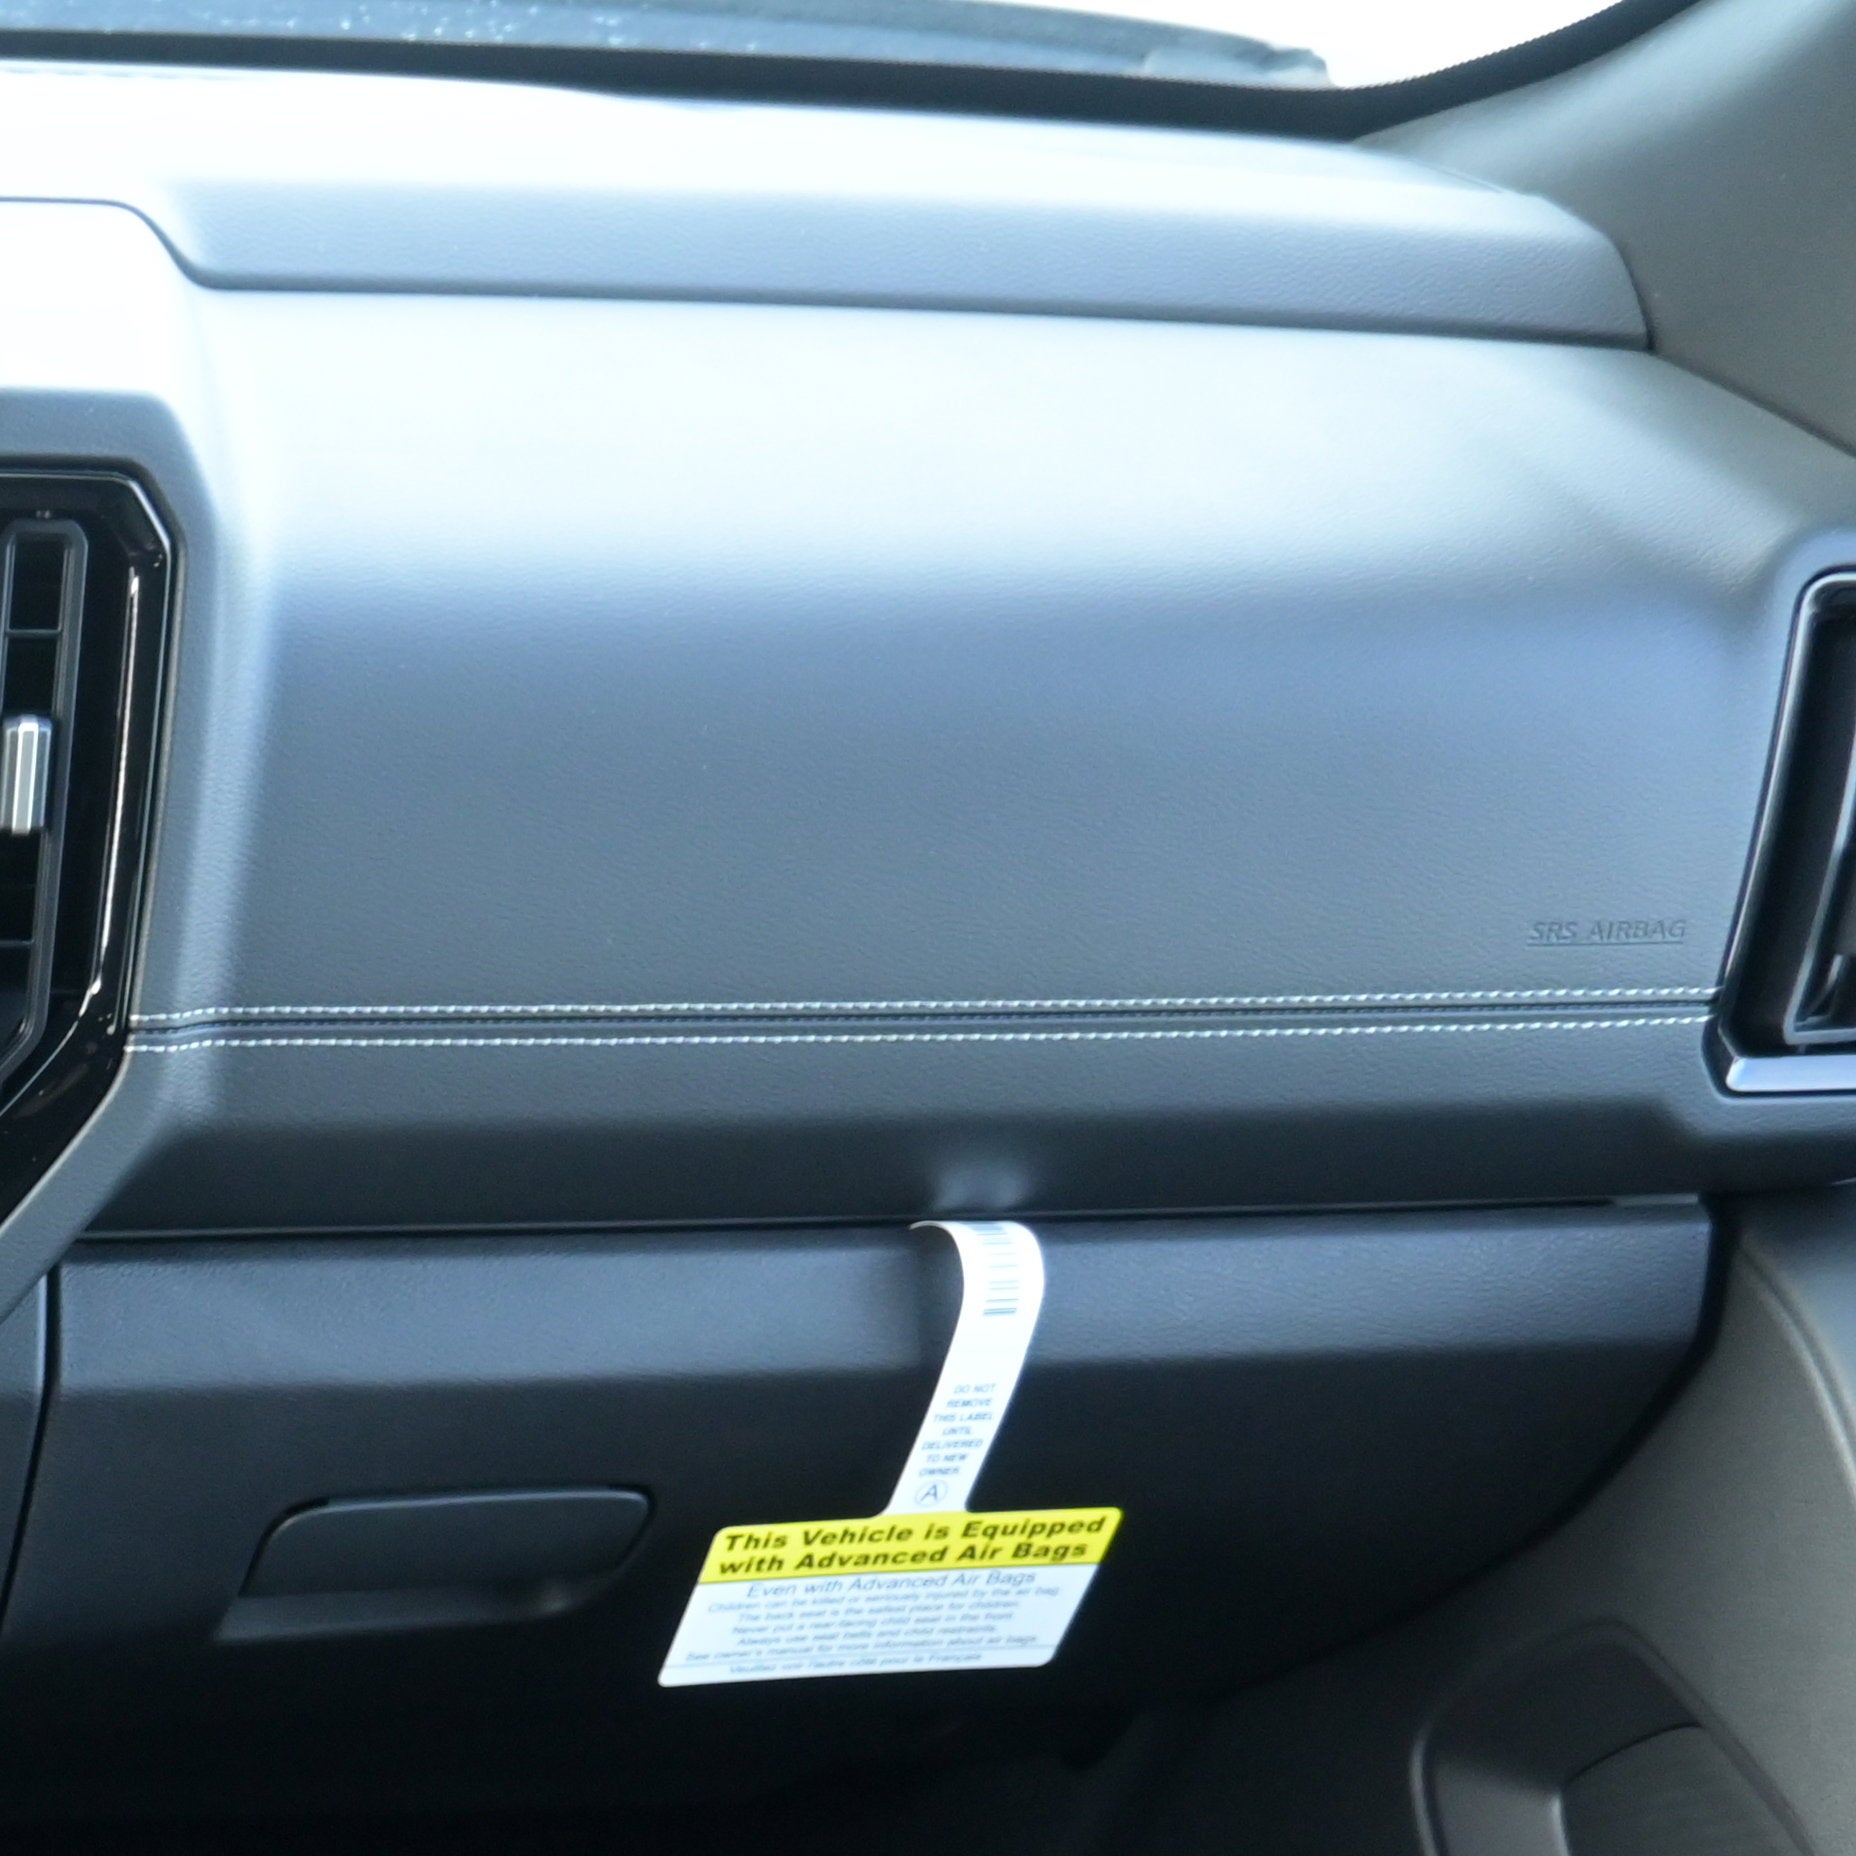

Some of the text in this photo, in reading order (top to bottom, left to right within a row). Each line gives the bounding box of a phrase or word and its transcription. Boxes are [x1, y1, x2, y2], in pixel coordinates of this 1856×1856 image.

[1529, 919, 1687, 941] SRS AIRBAG
[919, 1484, 938, 1501] A
[725, 1516, 1107, 1552] This Vehicle is Equipped
[718, 1541, 1089, 1576] with Advanced Air Bags
[747, 1570, 1037, 1598] Even with Advanced Air Bags
